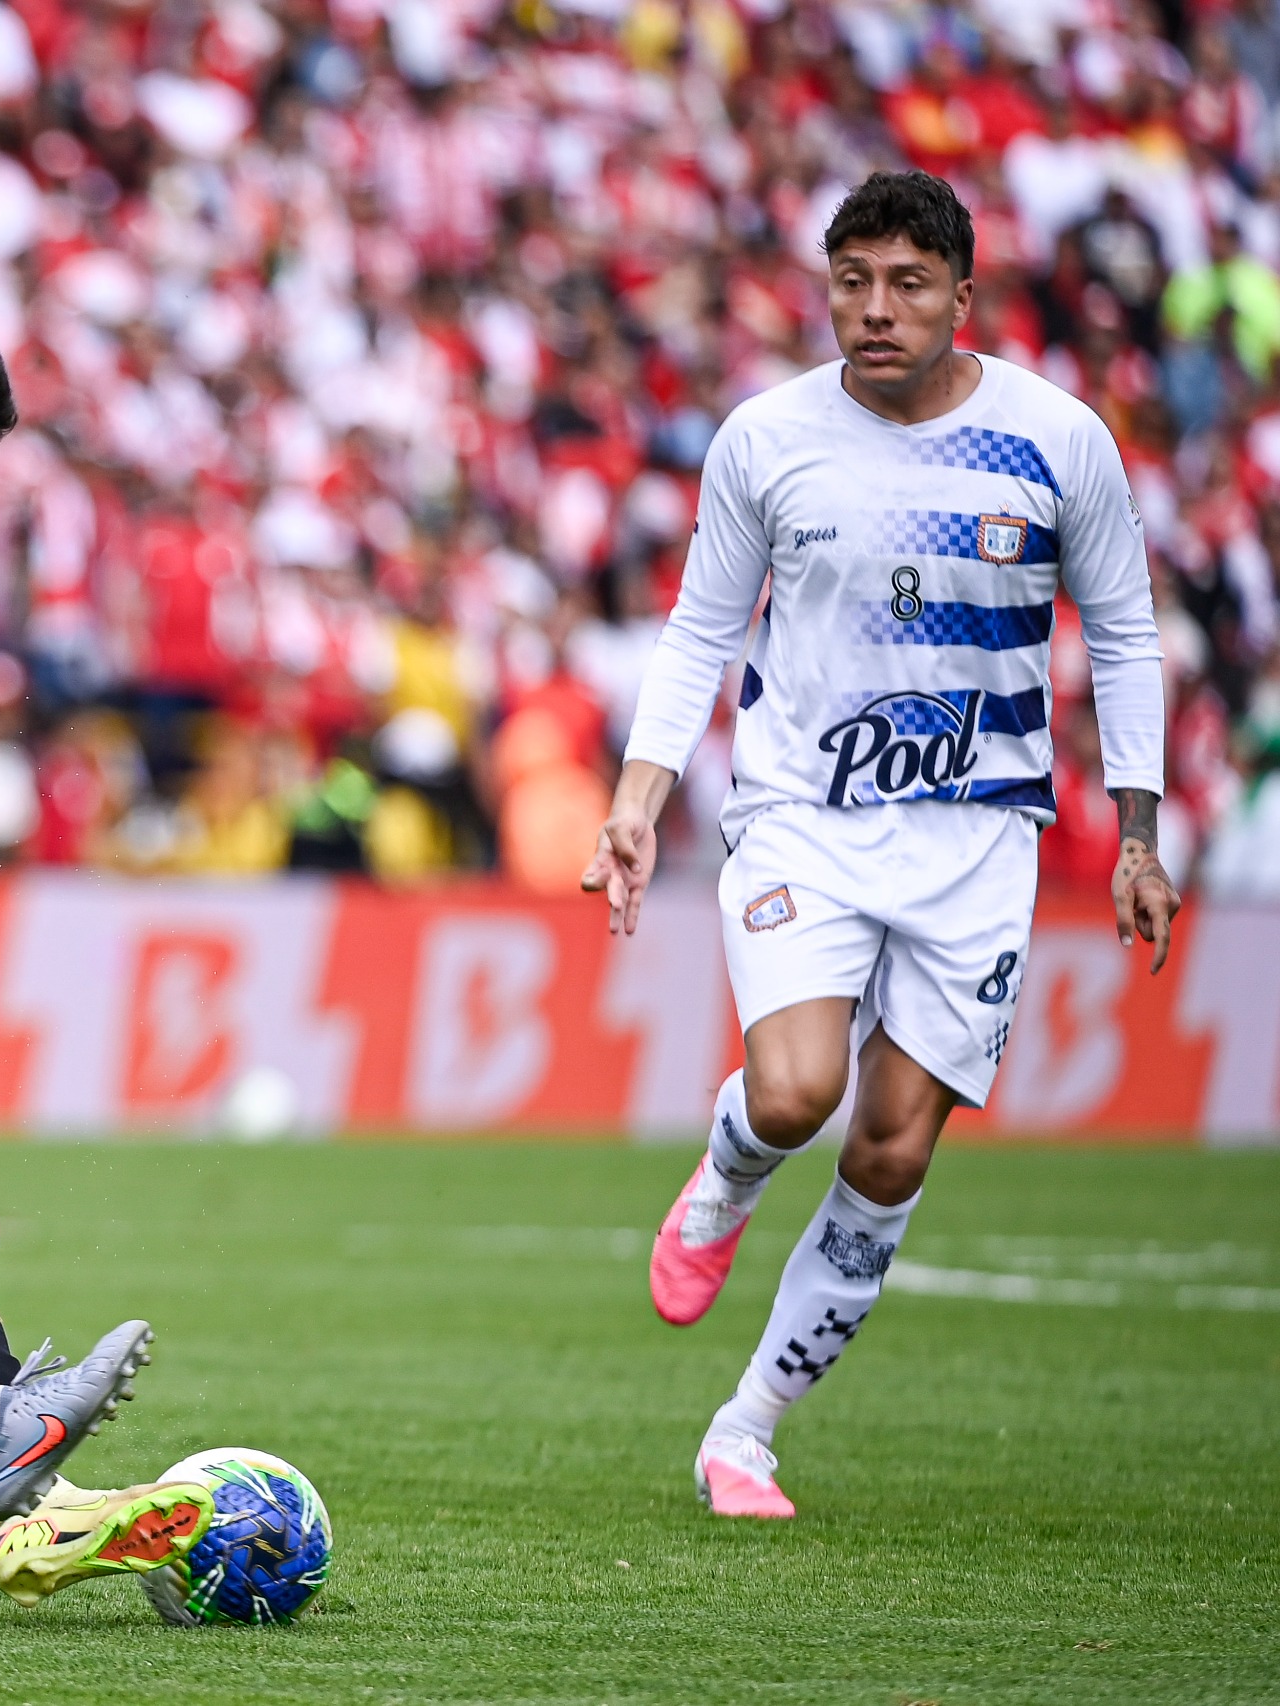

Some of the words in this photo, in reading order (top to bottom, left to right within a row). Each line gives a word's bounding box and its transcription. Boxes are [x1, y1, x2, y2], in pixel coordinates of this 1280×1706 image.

[890, 565, 923, 622] 8
[818, 687, 988, 806] Pool
[976, 950, 1018, 1005] 8
